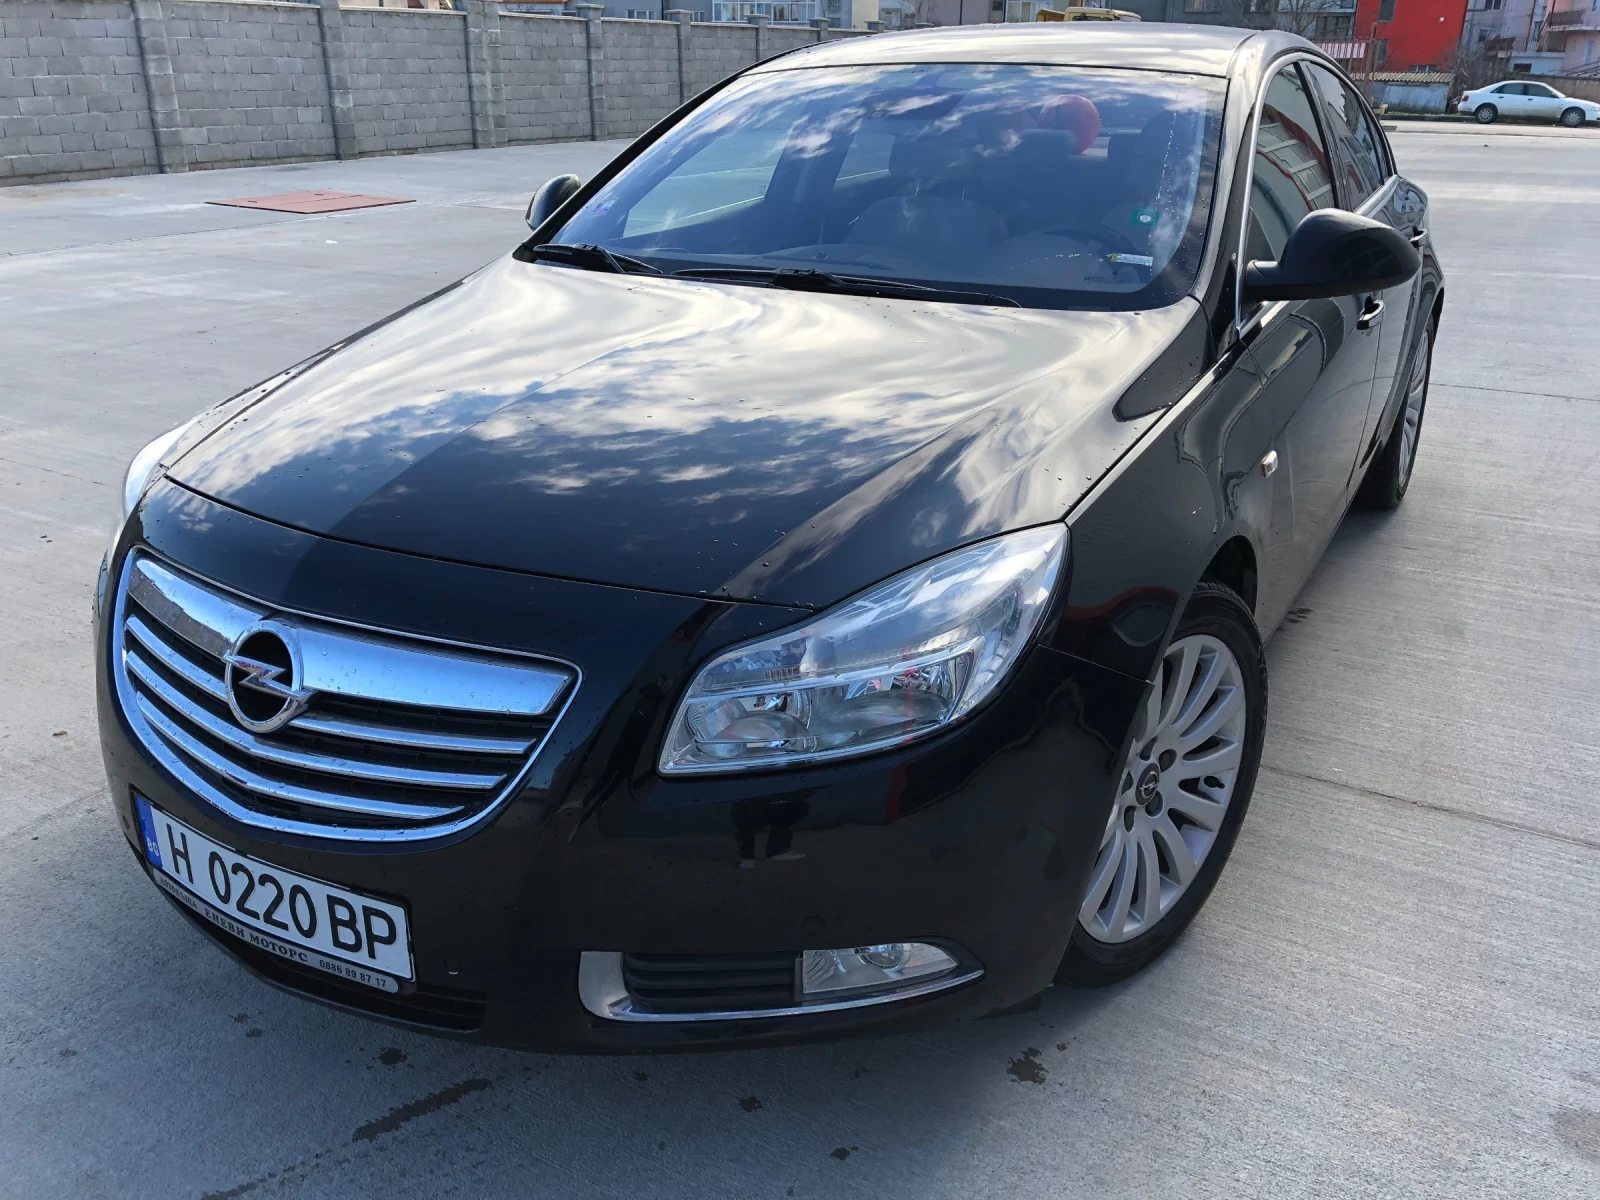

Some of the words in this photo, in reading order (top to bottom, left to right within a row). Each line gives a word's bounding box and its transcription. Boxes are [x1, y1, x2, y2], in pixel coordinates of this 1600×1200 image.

[146, 836, 160, 857] BG
[166, 822, 194, 885] H
[208, 850, 317, 939] 0220
[326, 893, 397, 960] BP
[204, 907, 245, 938] ЕНЕВИ
[249, 932, 308, 962] МОТОРС
[319, 959, 343, 974] 0886
[345, 966, 358, 979] 89
[360, 972, 373, 984] 87
[375, 977, 387, 988] 17
